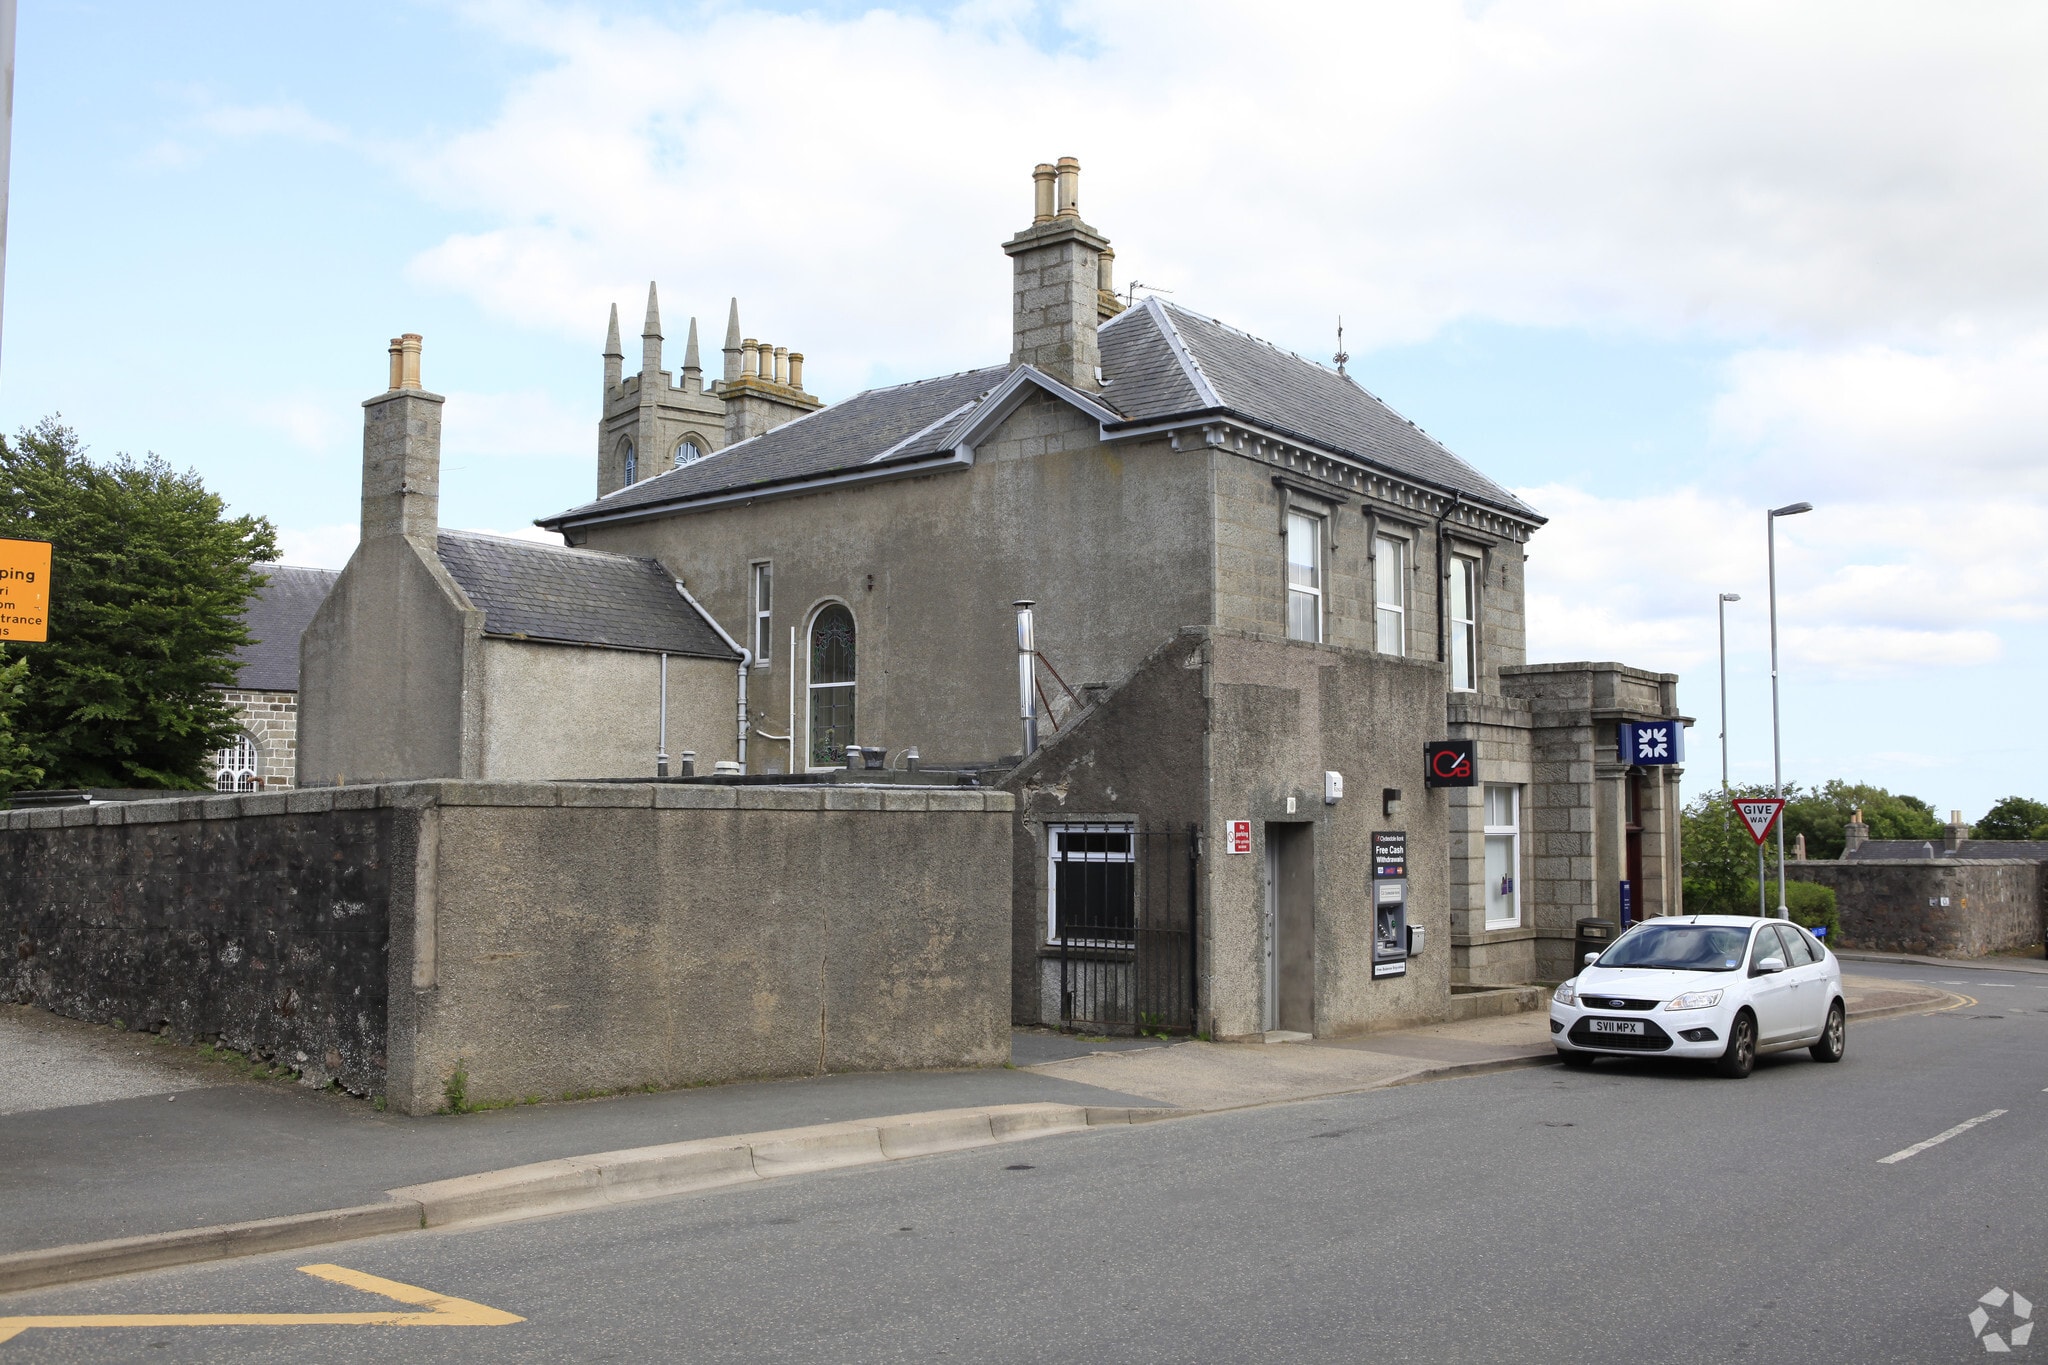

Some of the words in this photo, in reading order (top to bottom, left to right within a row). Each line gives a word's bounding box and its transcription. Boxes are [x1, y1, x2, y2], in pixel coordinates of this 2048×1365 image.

[1, 614, 42, 625] trance
[1743, 805, 1772, 815] GIVE
[1375, 846, 1388, 854] Free
[1389, 845, 1404, 854] Cash
[1596, 1021, 1615, 1031] SV11
[1616, 1022, 1636, 1032] MPX
